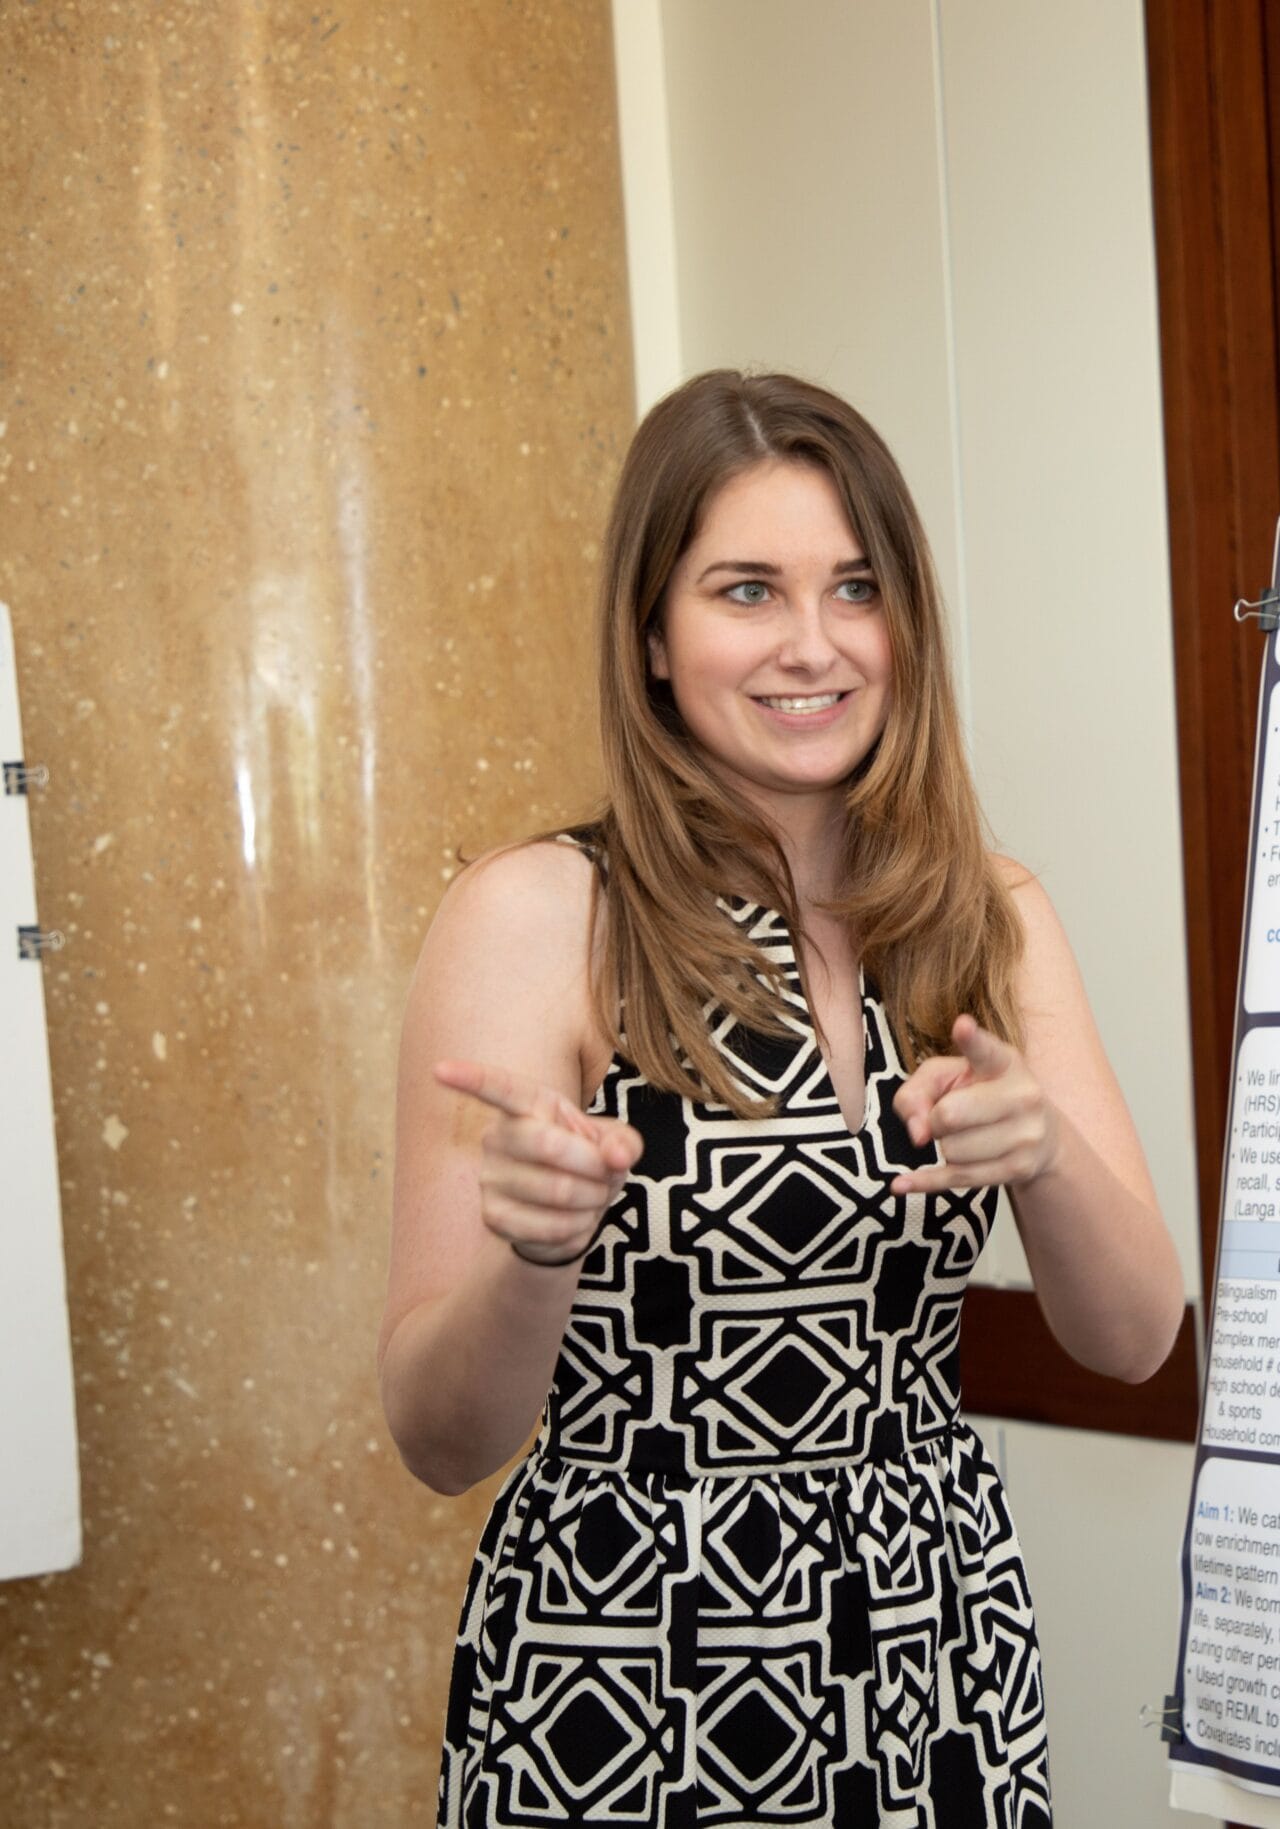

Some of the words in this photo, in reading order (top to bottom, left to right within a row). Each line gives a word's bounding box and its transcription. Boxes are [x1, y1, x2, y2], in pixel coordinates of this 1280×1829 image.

[1247, 1070, 1265, 1085] We
[1236, 1174, 1270, 1192] recall,
[1196, 1502, 1220, 1521] Aim
[1223, 1505, 1233, 1522] 1:
[1238, 1506, 1258, 1526] We
[1225, 1646, 1254, 1664] other
[1196, 1719, 1251, 1751] Covariates
